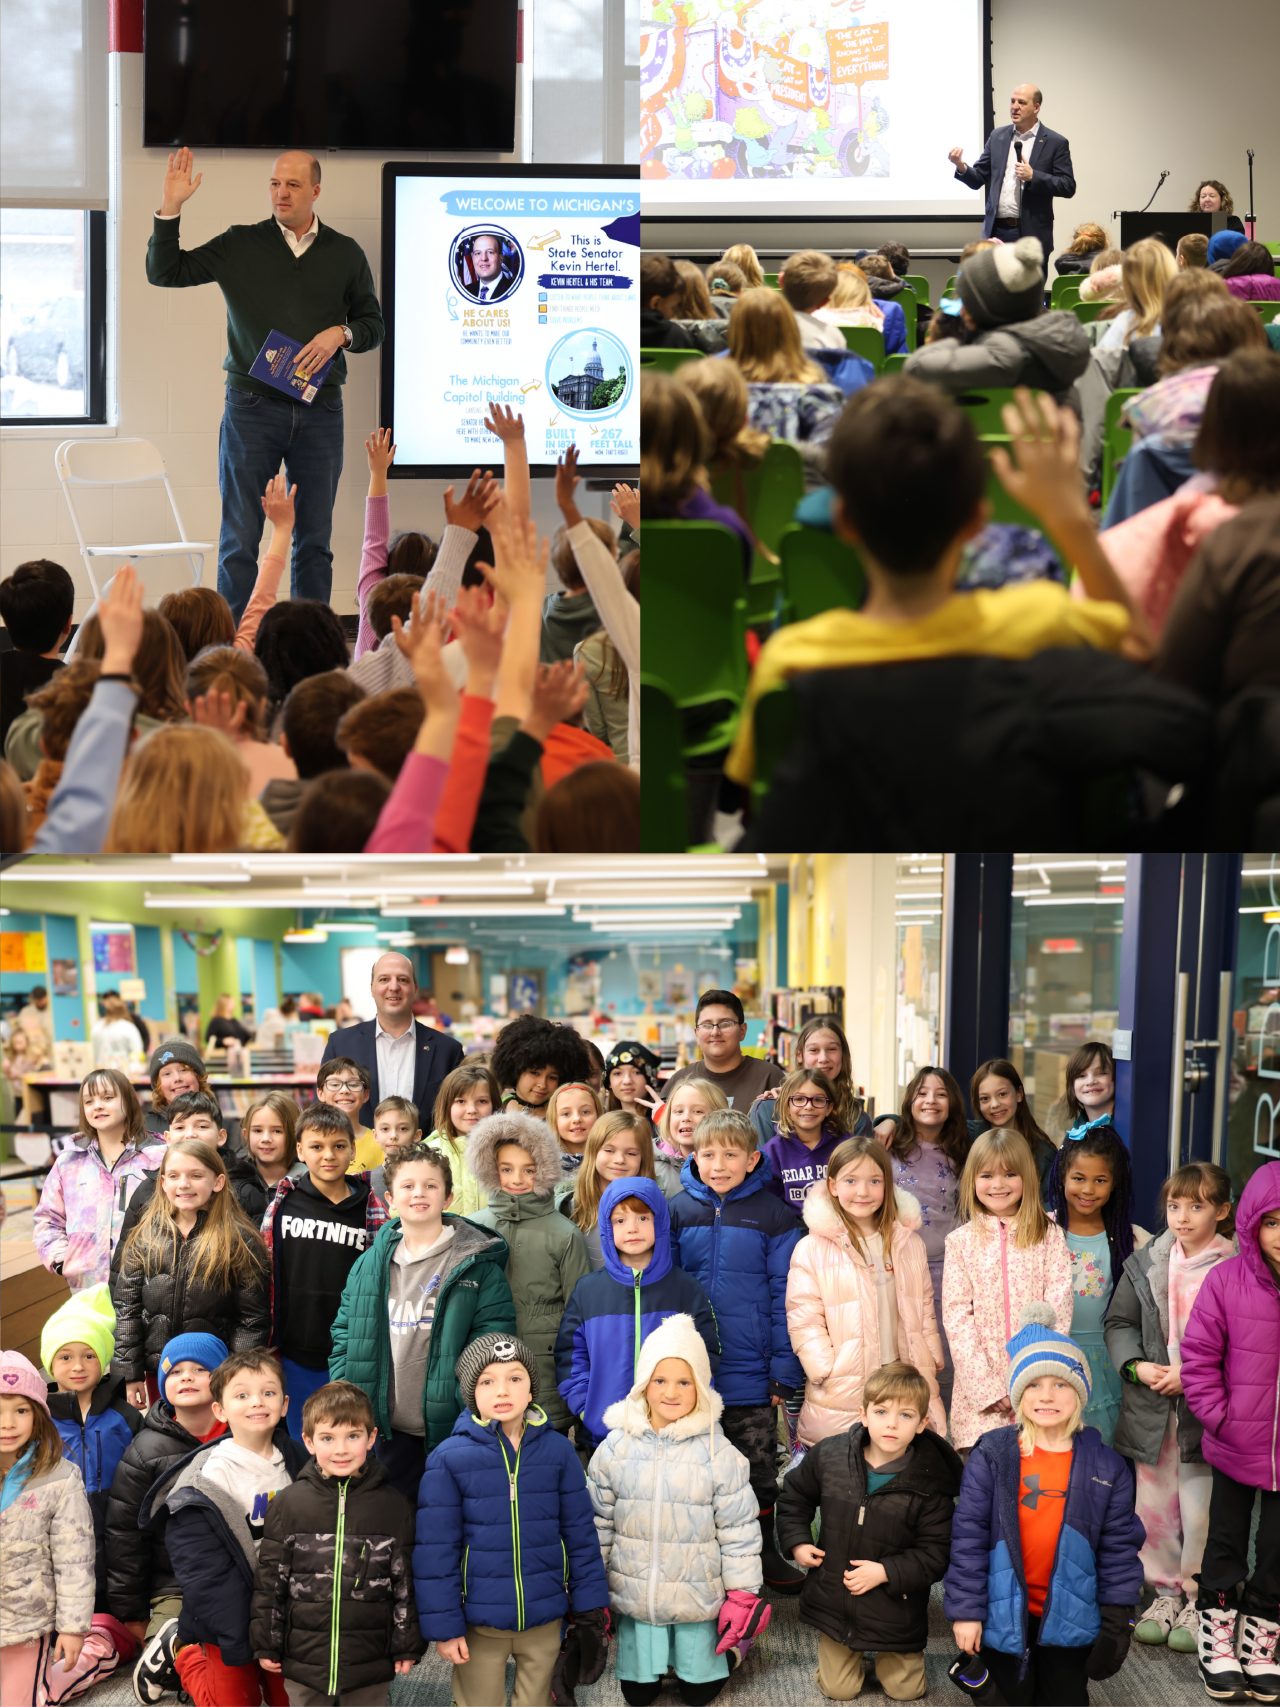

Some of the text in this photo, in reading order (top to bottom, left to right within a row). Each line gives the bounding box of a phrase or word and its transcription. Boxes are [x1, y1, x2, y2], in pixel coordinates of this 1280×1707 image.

[836, 28, 871, 40] THE CAT
[836, 60, 888, 78] EVERYTHING
[456, 198, 634, 212] WELCOME TO MICHIGAN'S
[571, 234, 602, 246] This is
[548, 248, 623, 259] State Senator
[551, 260, 620, 272] Kevin Hertel.
[550, 278, 565, 286] KEVIN
[566, 278, 584, 286] HERTEL
[590, 278, 598, 286] HIS
[464, 310, 508, 318] HE CARES
[462, 319, 510, 327] ABOUT US!
[449, 374, 520, 388] The Michigan
[444, 391, 526, 404] Capitol Building
[546, 428, 576, 439] BUILT
[600, 428, 622, 439] 267
[546, 440, 556, 448] IN
[590, 440, 633, 448] FEET TALL
[790, 1190, 802, 1199] 18
[281, 1215, 367, 1251] FORTNITE
